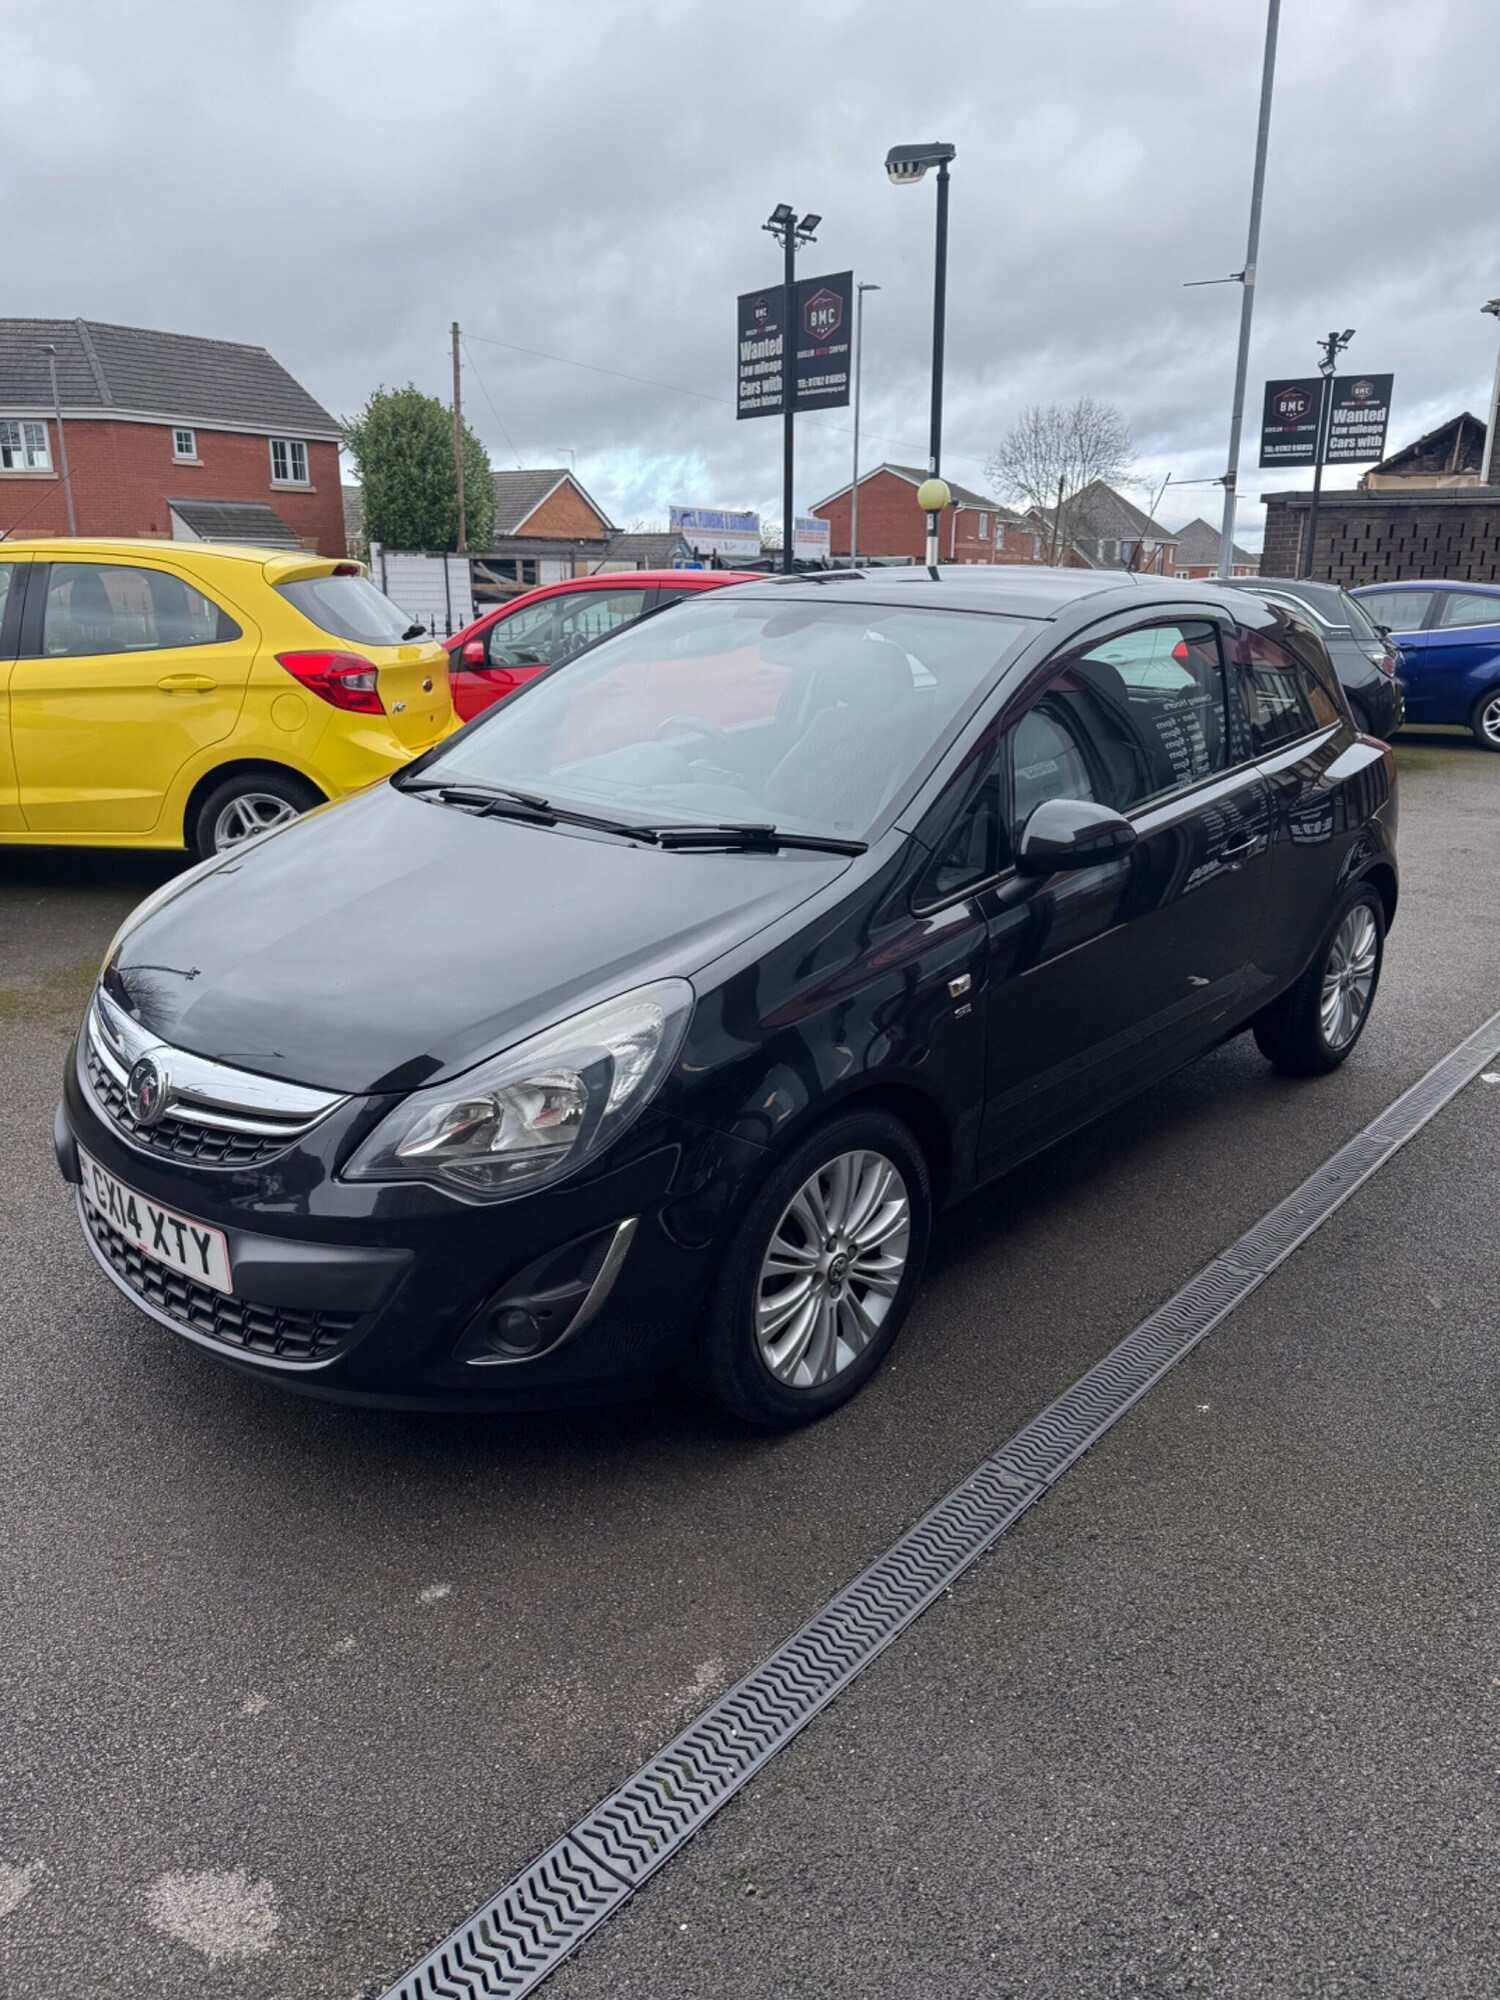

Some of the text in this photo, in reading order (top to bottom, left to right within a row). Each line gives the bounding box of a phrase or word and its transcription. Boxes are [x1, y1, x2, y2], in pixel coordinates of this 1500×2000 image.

[810, 308, 836, 327] BMC
[740, 334, 783, 362] Wanted
[740, 360, 783, 378] Low mileage
[740, 380, 761, 397] Cars
[761, 375, 783, 393] with
[739, 394, 783, 410] service history
[1279, 401, 1305, 412] BMC
[1333, 407, 1387, 424] Wanted
[1331, 424, 1384, 435] Low mileage
[1330, 435, 1383, 449] Cars with
[1328, 448, 1381, 458] service history
[147, 1205, 211, 1275] XTY
